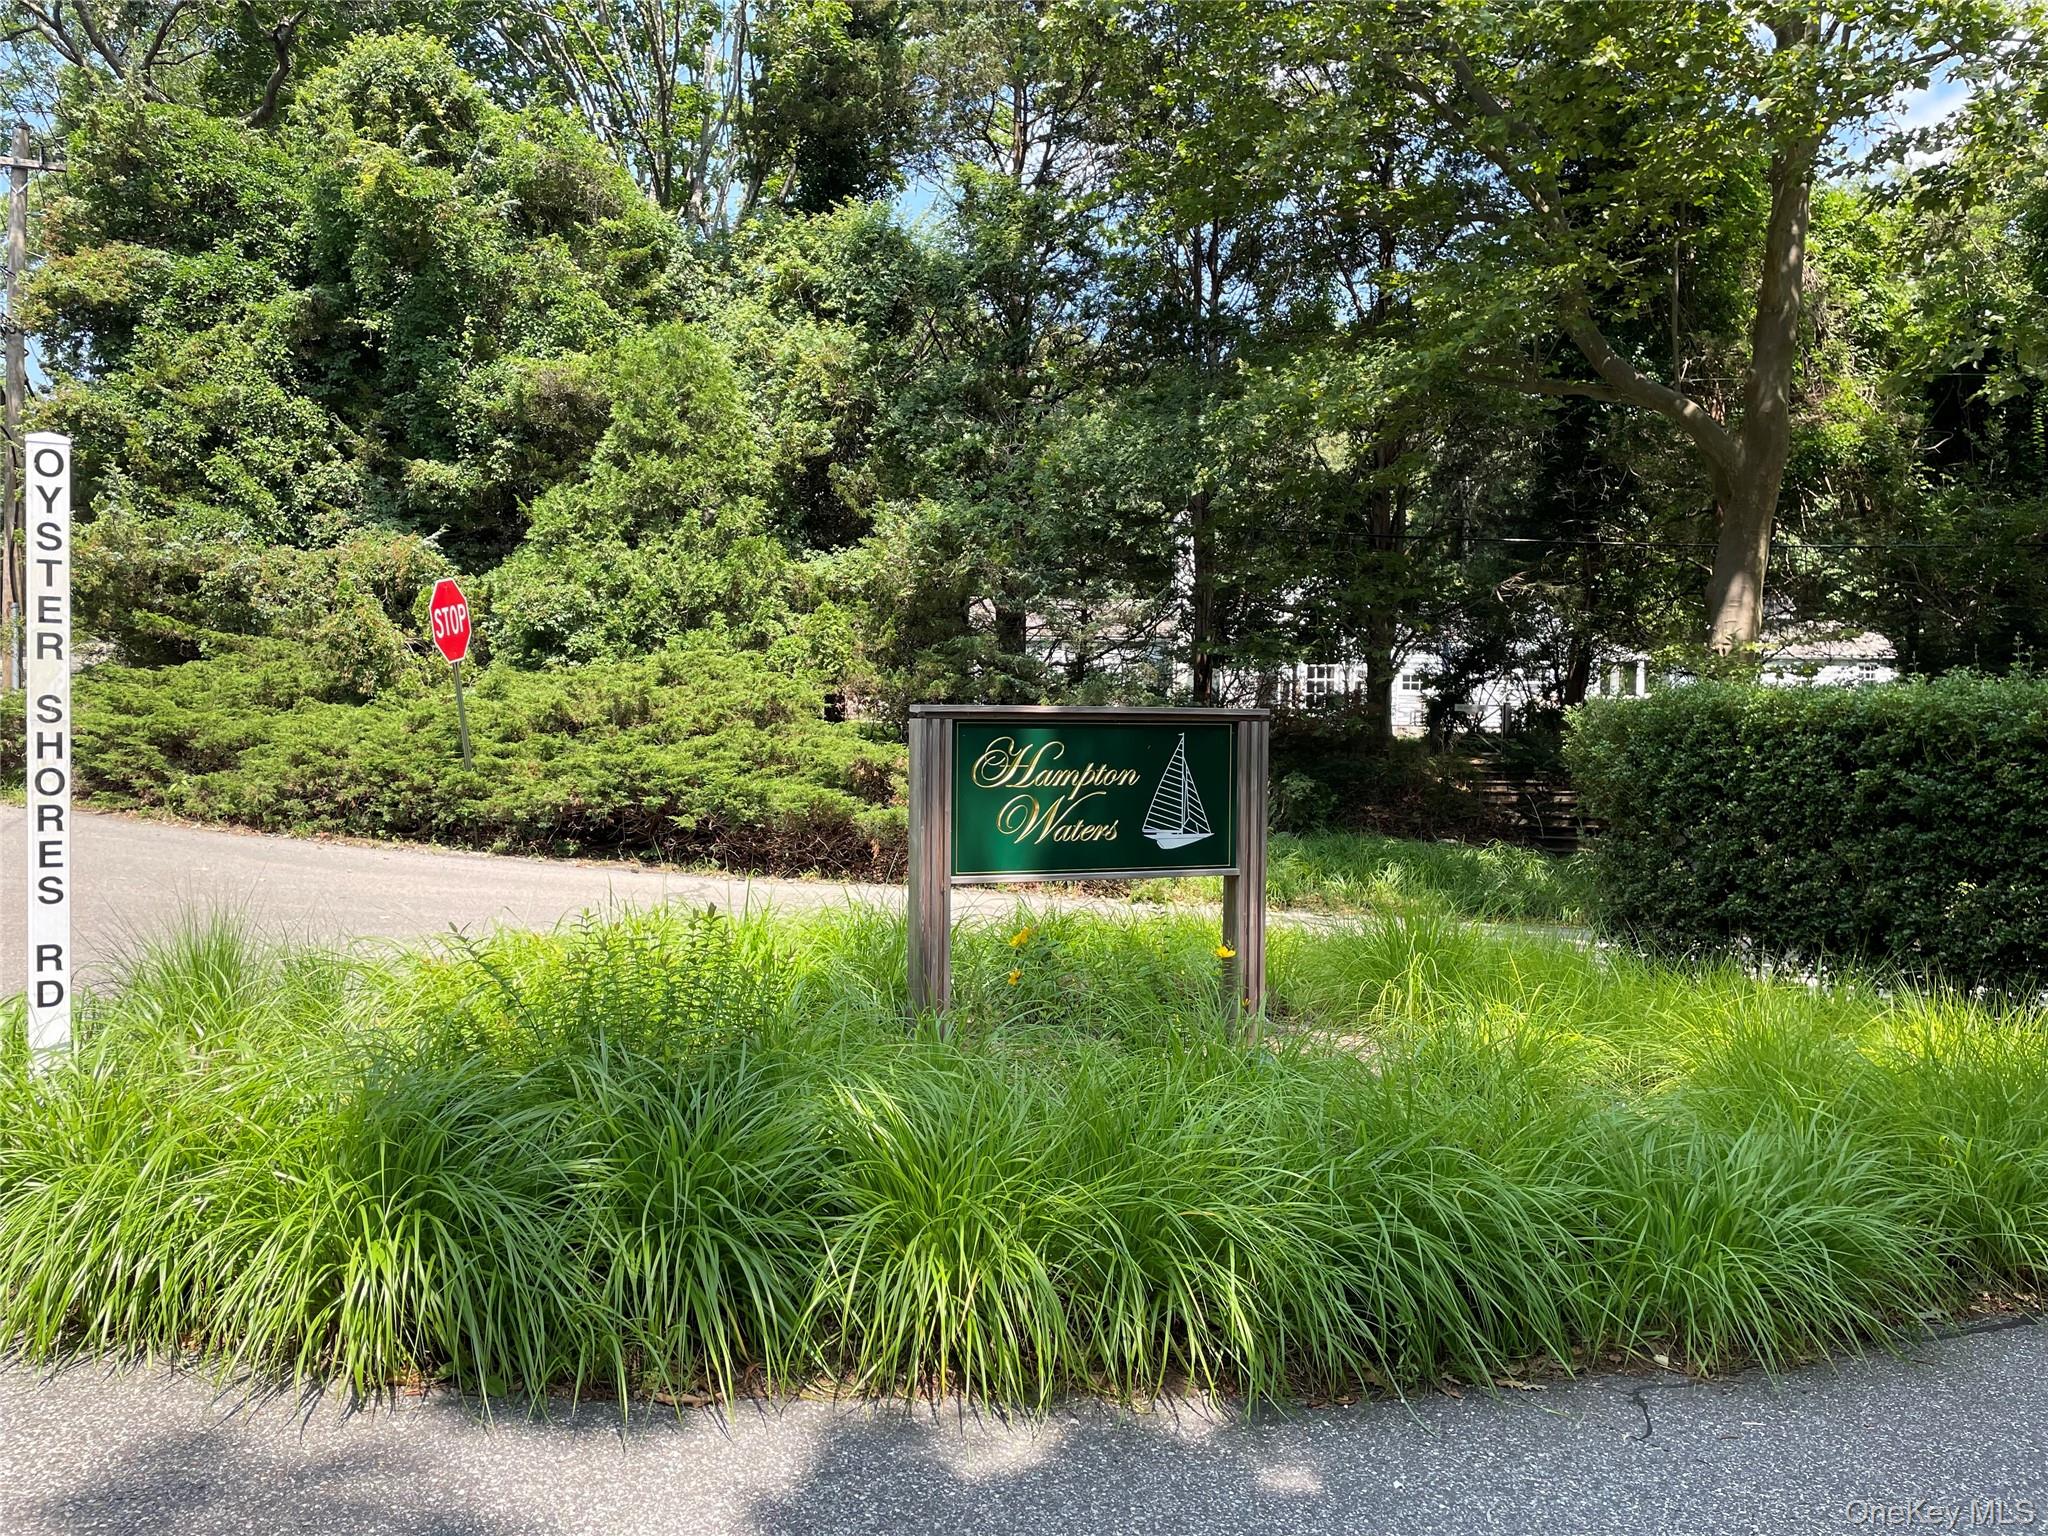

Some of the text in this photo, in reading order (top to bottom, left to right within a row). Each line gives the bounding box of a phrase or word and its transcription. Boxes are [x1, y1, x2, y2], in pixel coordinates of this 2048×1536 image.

[434, 603, 466, 639] STOP
[34, 448, 66, 1008] OYSTER SHORES RD
[971, 736, 1141, 801] Hampton
[996, 791, 1119, 845] Waters
